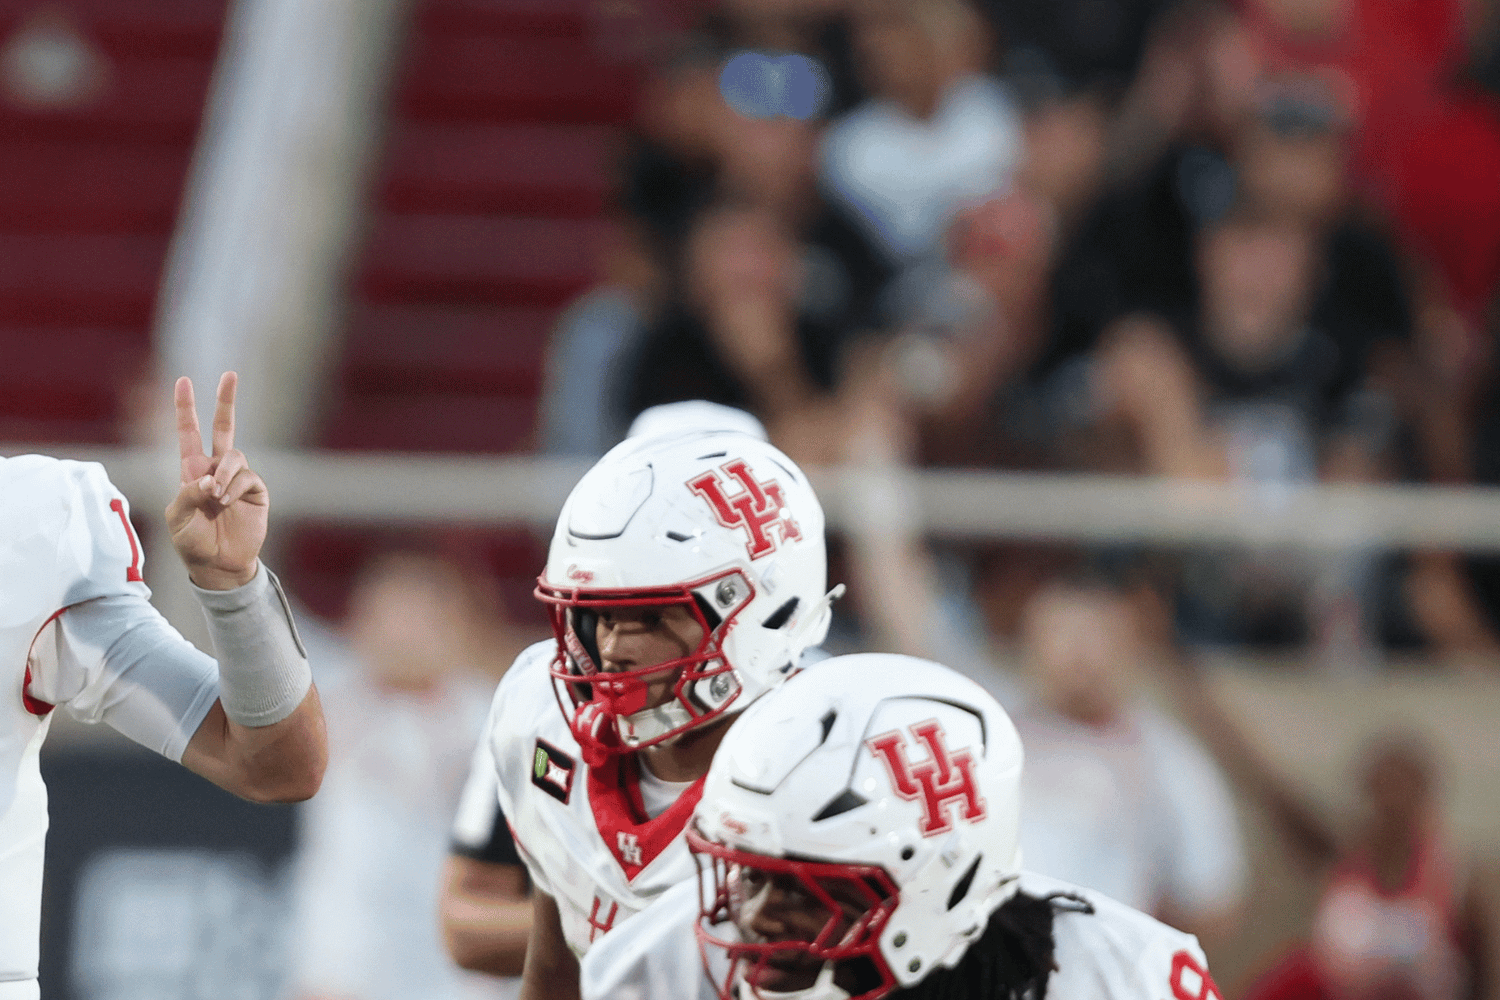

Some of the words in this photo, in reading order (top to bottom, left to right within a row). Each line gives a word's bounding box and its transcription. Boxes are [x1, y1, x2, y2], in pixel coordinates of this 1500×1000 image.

[109, 498, 146, 583] 1
[685, 457, 803, 561] UH
[864, 716, 989, 838] UH
[616, 831, 643, 867] UH
